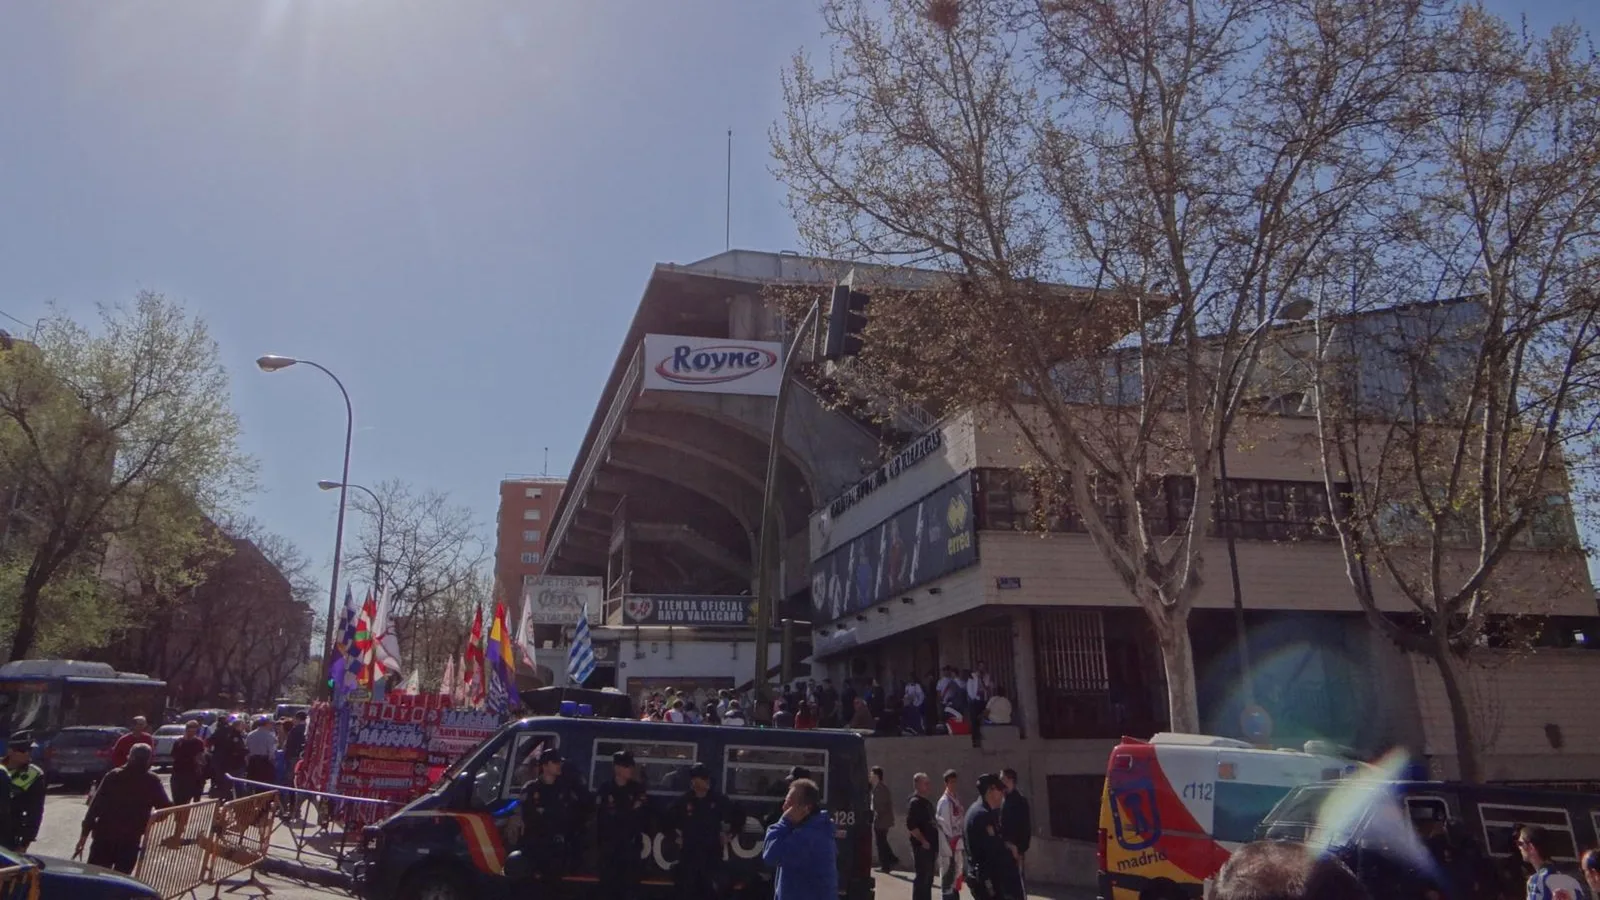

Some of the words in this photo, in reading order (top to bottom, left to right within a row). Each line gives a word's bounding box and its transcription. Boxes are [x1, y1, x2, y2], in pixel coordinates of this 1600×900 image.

[673, 345, 761, 373] Royne
[657, 599, 697, 610] TIENDA
[701, 600, 744, 611] OFICIAL
[657, 610, 684, 620] RAYO
[687, 611, 744, 622] VALLECANO
[1191, 782, 1212, 800] 112
[833, 811, 856, 826] 128
[1117, 849, 1168, 871] madrid
